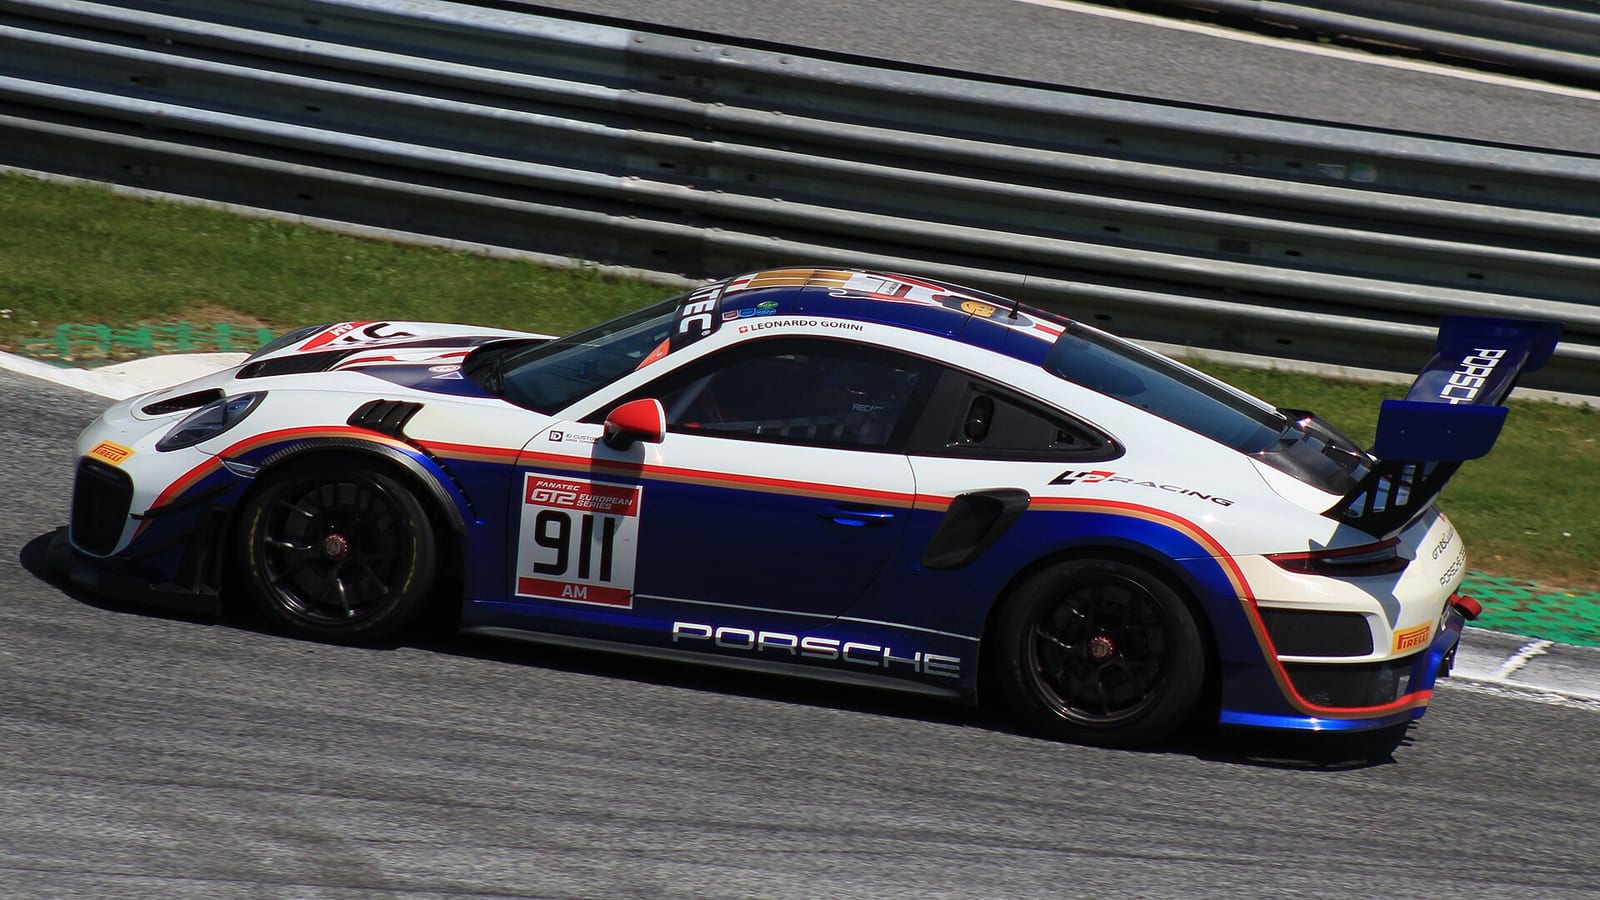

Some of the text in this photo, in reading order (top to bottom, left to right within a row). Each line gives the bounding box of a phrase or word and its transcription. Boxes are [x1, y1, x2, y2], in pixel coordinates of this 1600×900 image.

[751, 320, 864, 332] LEONARDO GORINI
[92, 443, 129, 462] PIRELLI
[536, 481, 581, 491] FANATEC
[1108, 477, 1235, 507] RACING
[531, 488, 633, 506] GT2 EUROPEAN
[576, 500, 612, 510] SERIES
[533, 509, 616, 583] 911
[562, 585, 588, 599] AM
[1396, 625, 1430, 650] PIRELLI
[672, 621, 961, 678] PORSCHE
